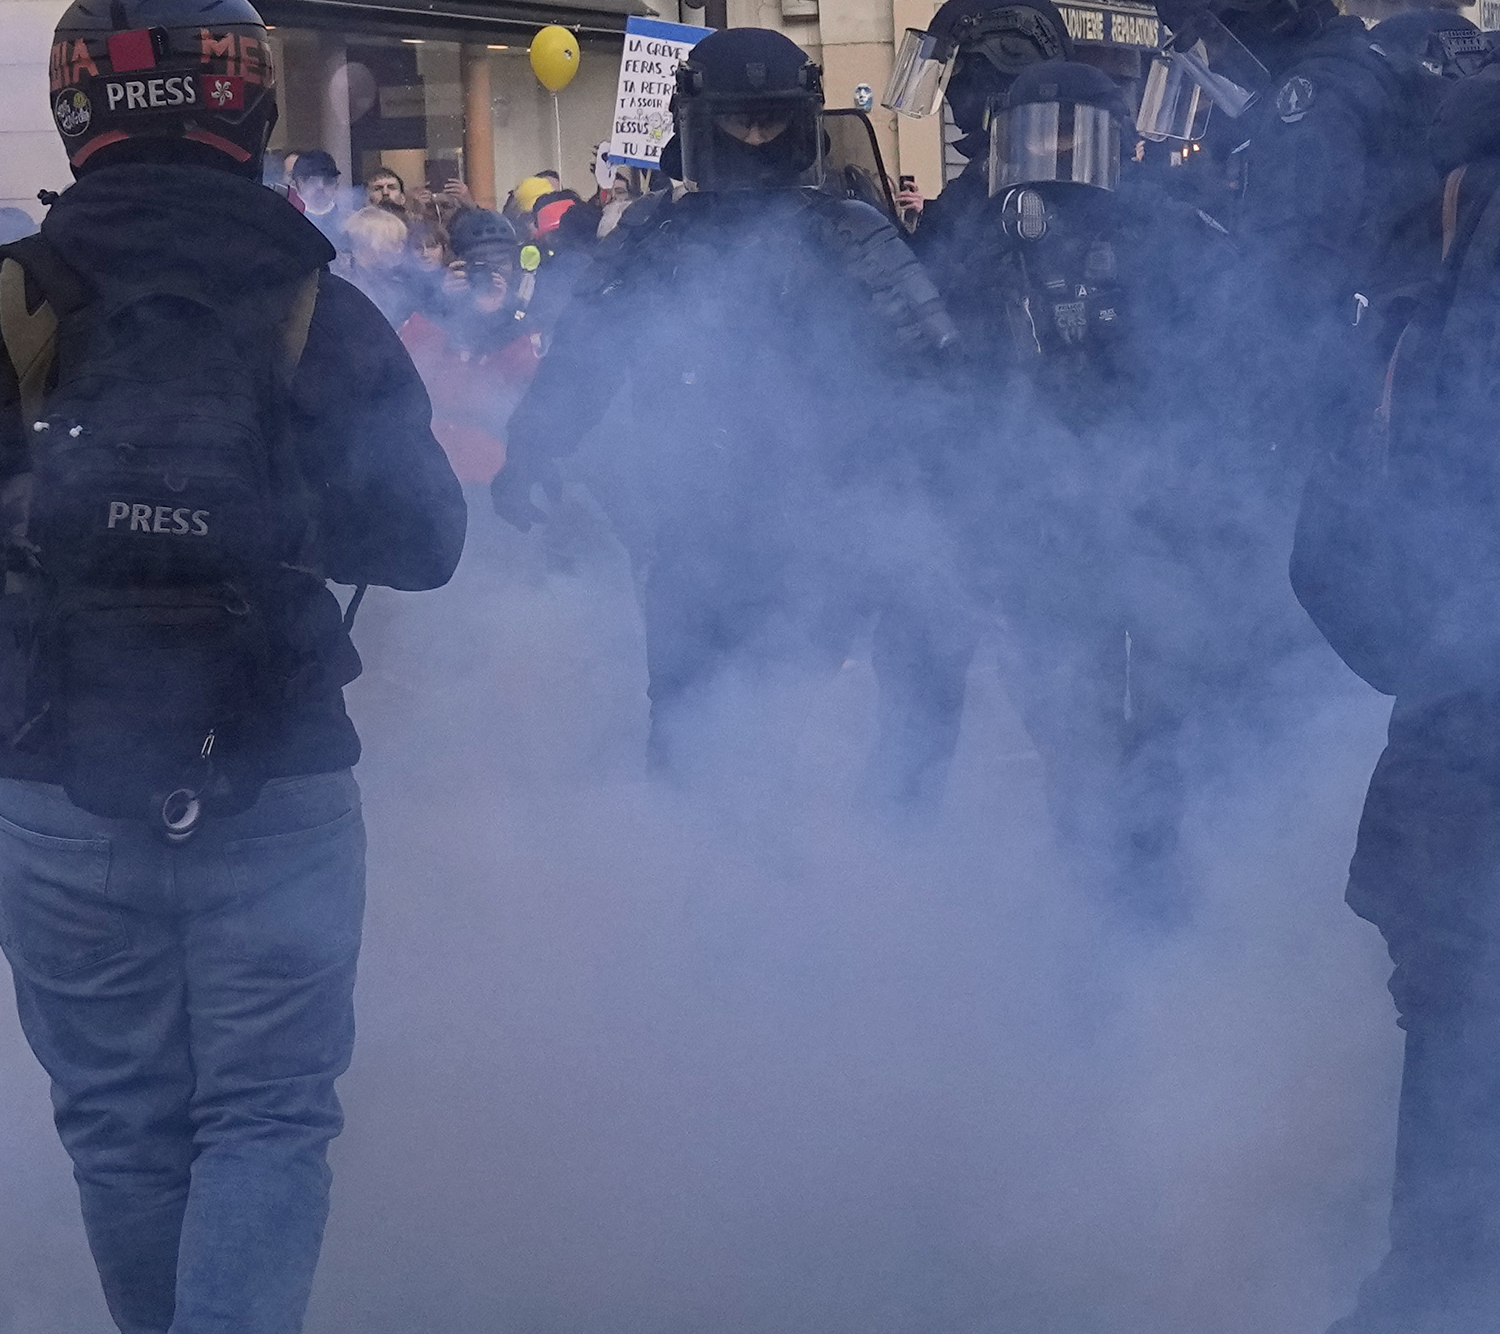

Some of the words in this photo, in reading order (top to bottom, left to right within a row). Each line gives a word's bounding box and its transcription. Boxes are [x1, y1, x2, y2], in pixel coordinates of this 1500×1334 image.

[629, 40, 643, 52] LA
[106, 75, 198, 111] PRESS
[624, 80, 636, 93] TA
[615, 121, 649, 135] DESSUS
[622, 141, 638, 156] TU
[644, 145, 665, 157] DE
[107, 501, 210, 536] PRESS
